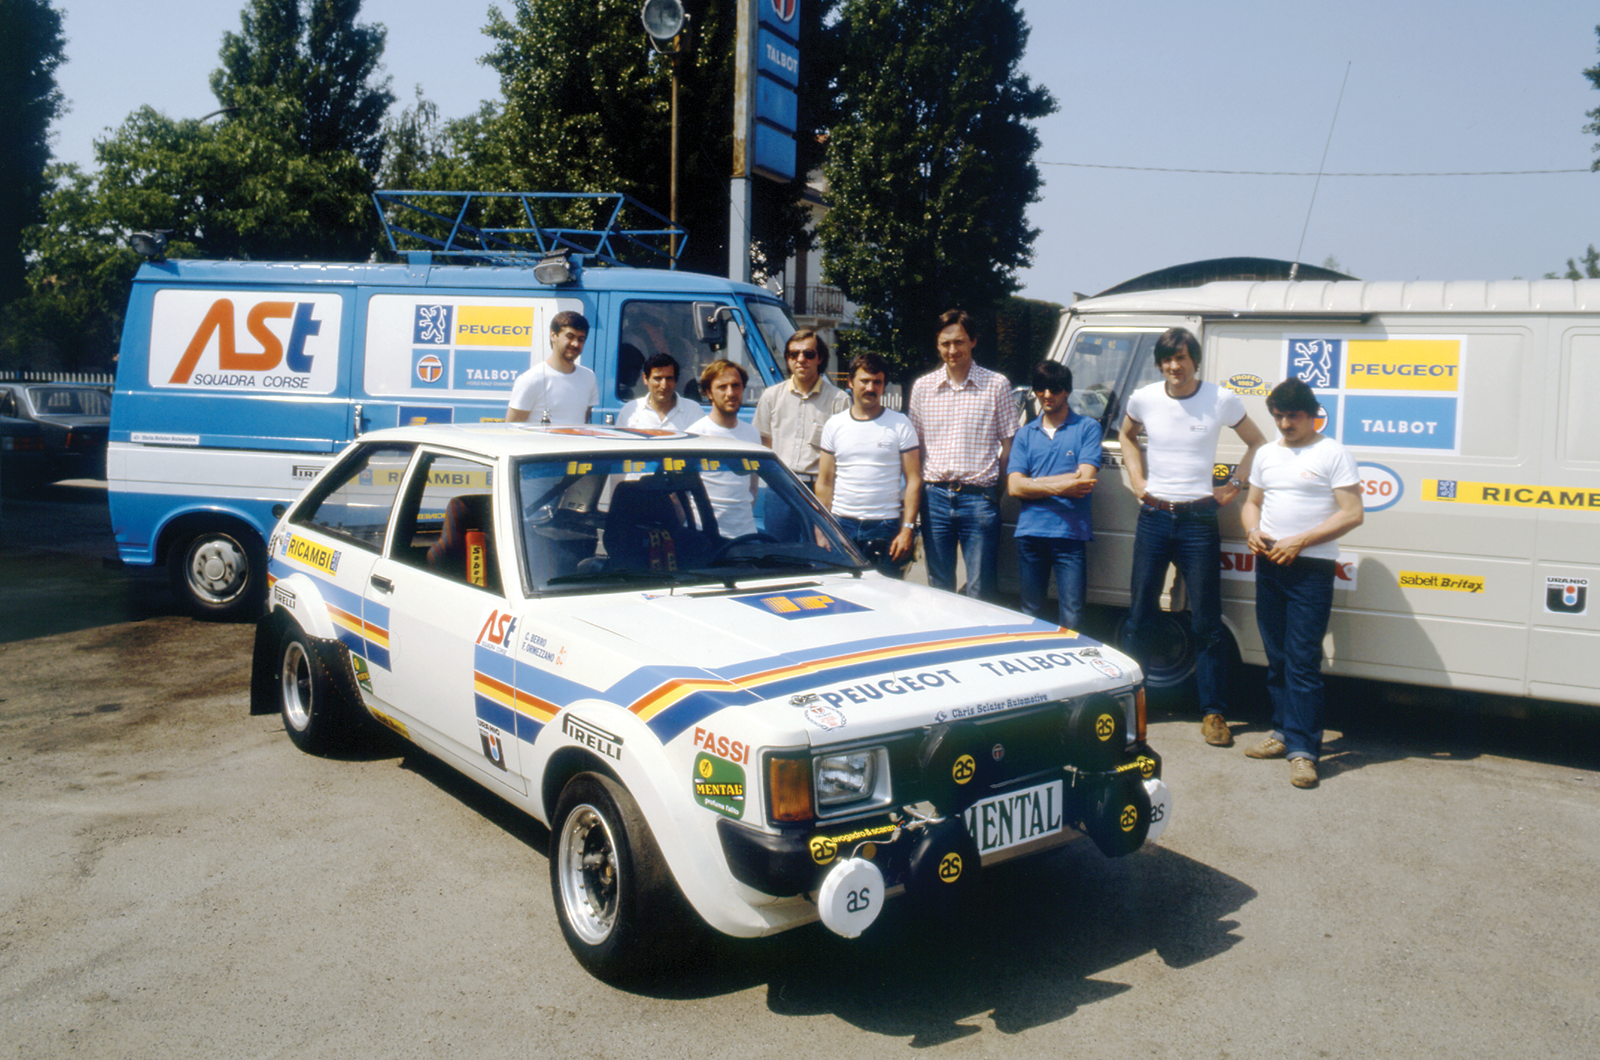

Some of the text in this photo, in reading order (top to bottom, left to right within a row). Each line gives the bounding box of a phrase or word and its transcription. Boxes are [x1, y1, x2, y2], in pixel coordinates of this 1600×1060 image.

[766, 43, 798, 73] TALBOT
[458, 324, 532, 335] PEUGEOT
[466, 368, 519, 380] TALBOT
[1231, 374, 1262, 383] TROFEO
[1350, 363, 1458, 377] PEUGEOT
[193, 374, 310, 389] SQUADRA CORSE
[1229, 387, 1269, 396] UGEOT
[1361, 419, 1438, 435] TALBOT
[288, 538, 331, 569] RICAMBI
[472, 546, 481, 584] Sabel
[1400, 573, 1484, 593] sabelt Britax
[1547, 577, 1588, 585] URANIO
[274, 584, 296, 609] PIRELLI
[530, 633, 547, 648] BERRO
[526, 643, 555, 662] ORMEZZANO
[819, 669, 961, 708] PEUGEOT
[979, 651, 1086, 677] TALBOT
[952, 708, 975, 719] Chris
[477, 718, 501, 736] URANIO
[562, 712, 625, 761] PIRELLI
[694, 726, 751, 765] FASSI
[955, 758, 974, 780] as
[940, 856, 961, 879] as
[846, 887, 870, 913] as
